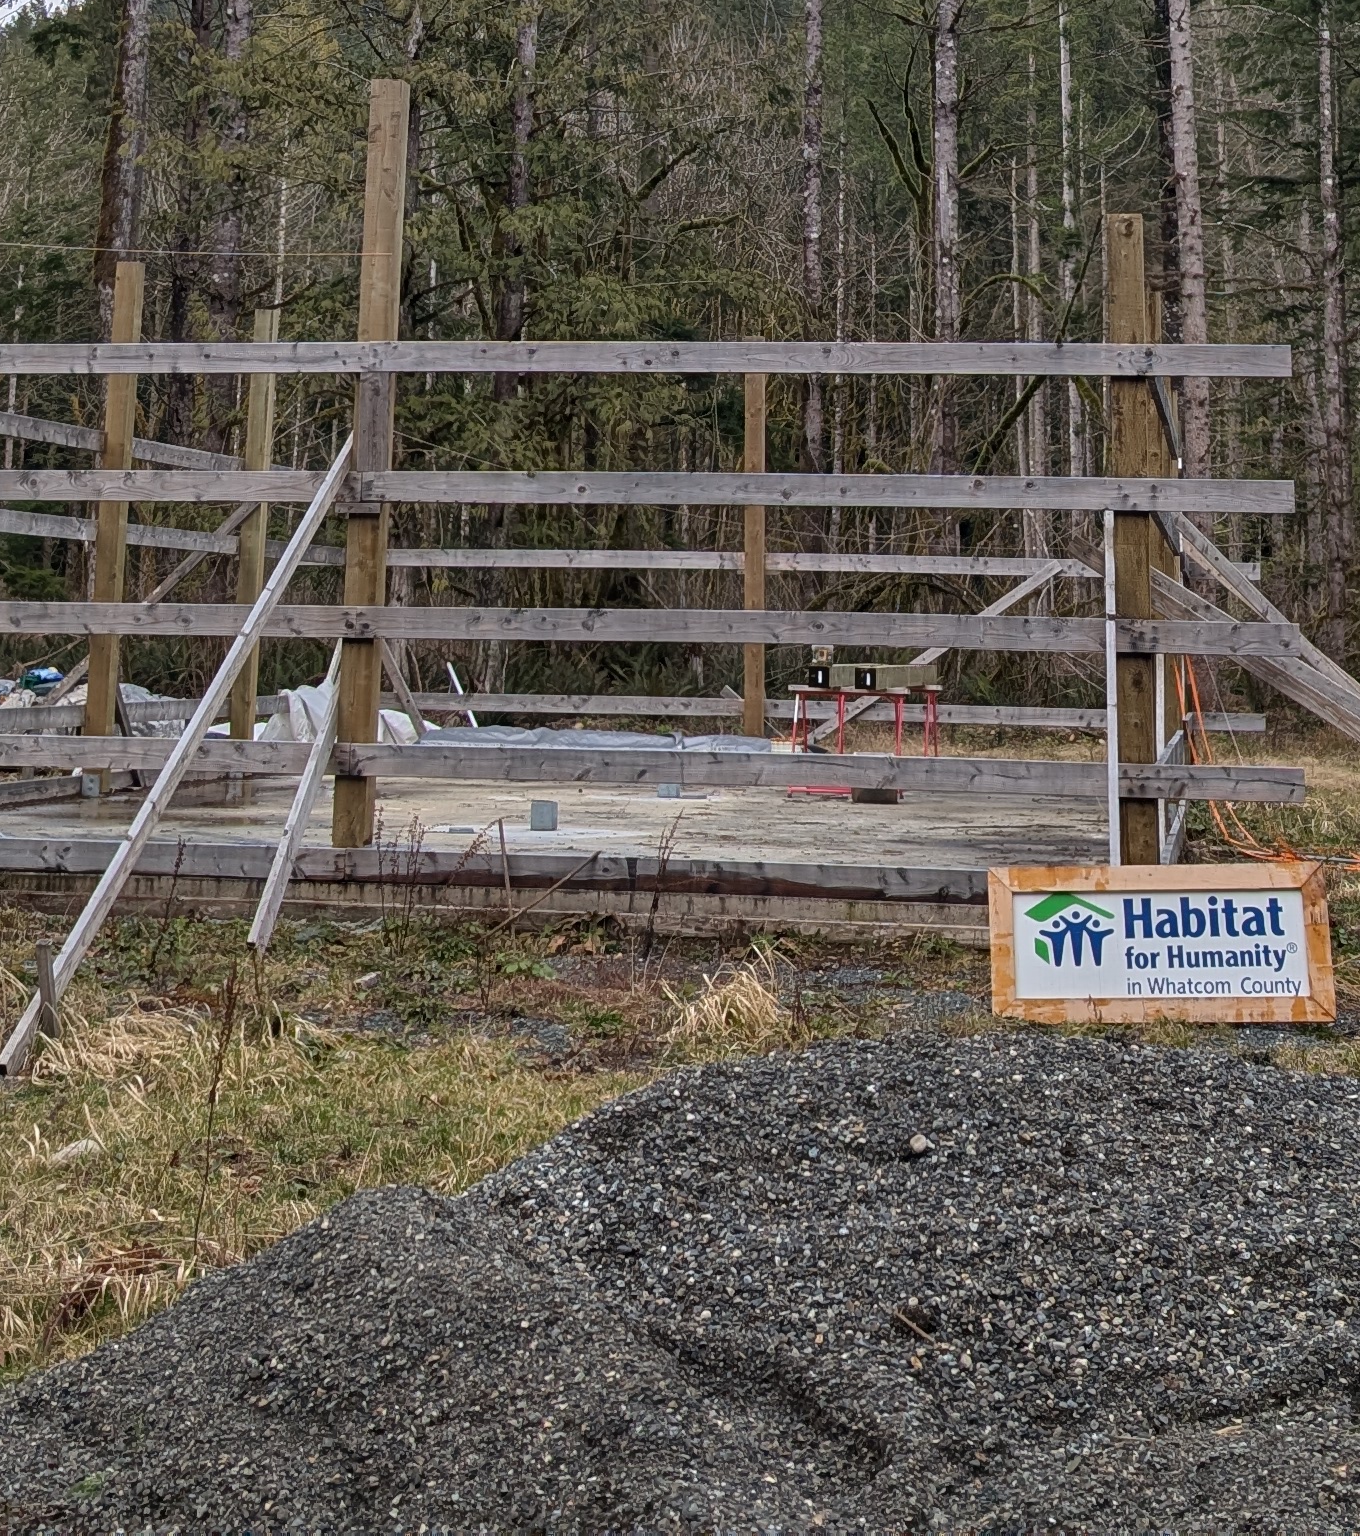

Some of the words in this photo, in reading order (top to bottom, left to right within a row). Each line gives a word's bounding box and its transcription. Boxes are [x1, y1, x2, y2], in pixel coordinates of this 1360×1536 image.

[1122, 895, 1286, 939] Habitat
[1125, 945, 1160, 970] for
[1127, 977, 1142, 995] in
[1147, 977, 1232, 995] Whatcom
[1240, 976, 1302, 997] County
